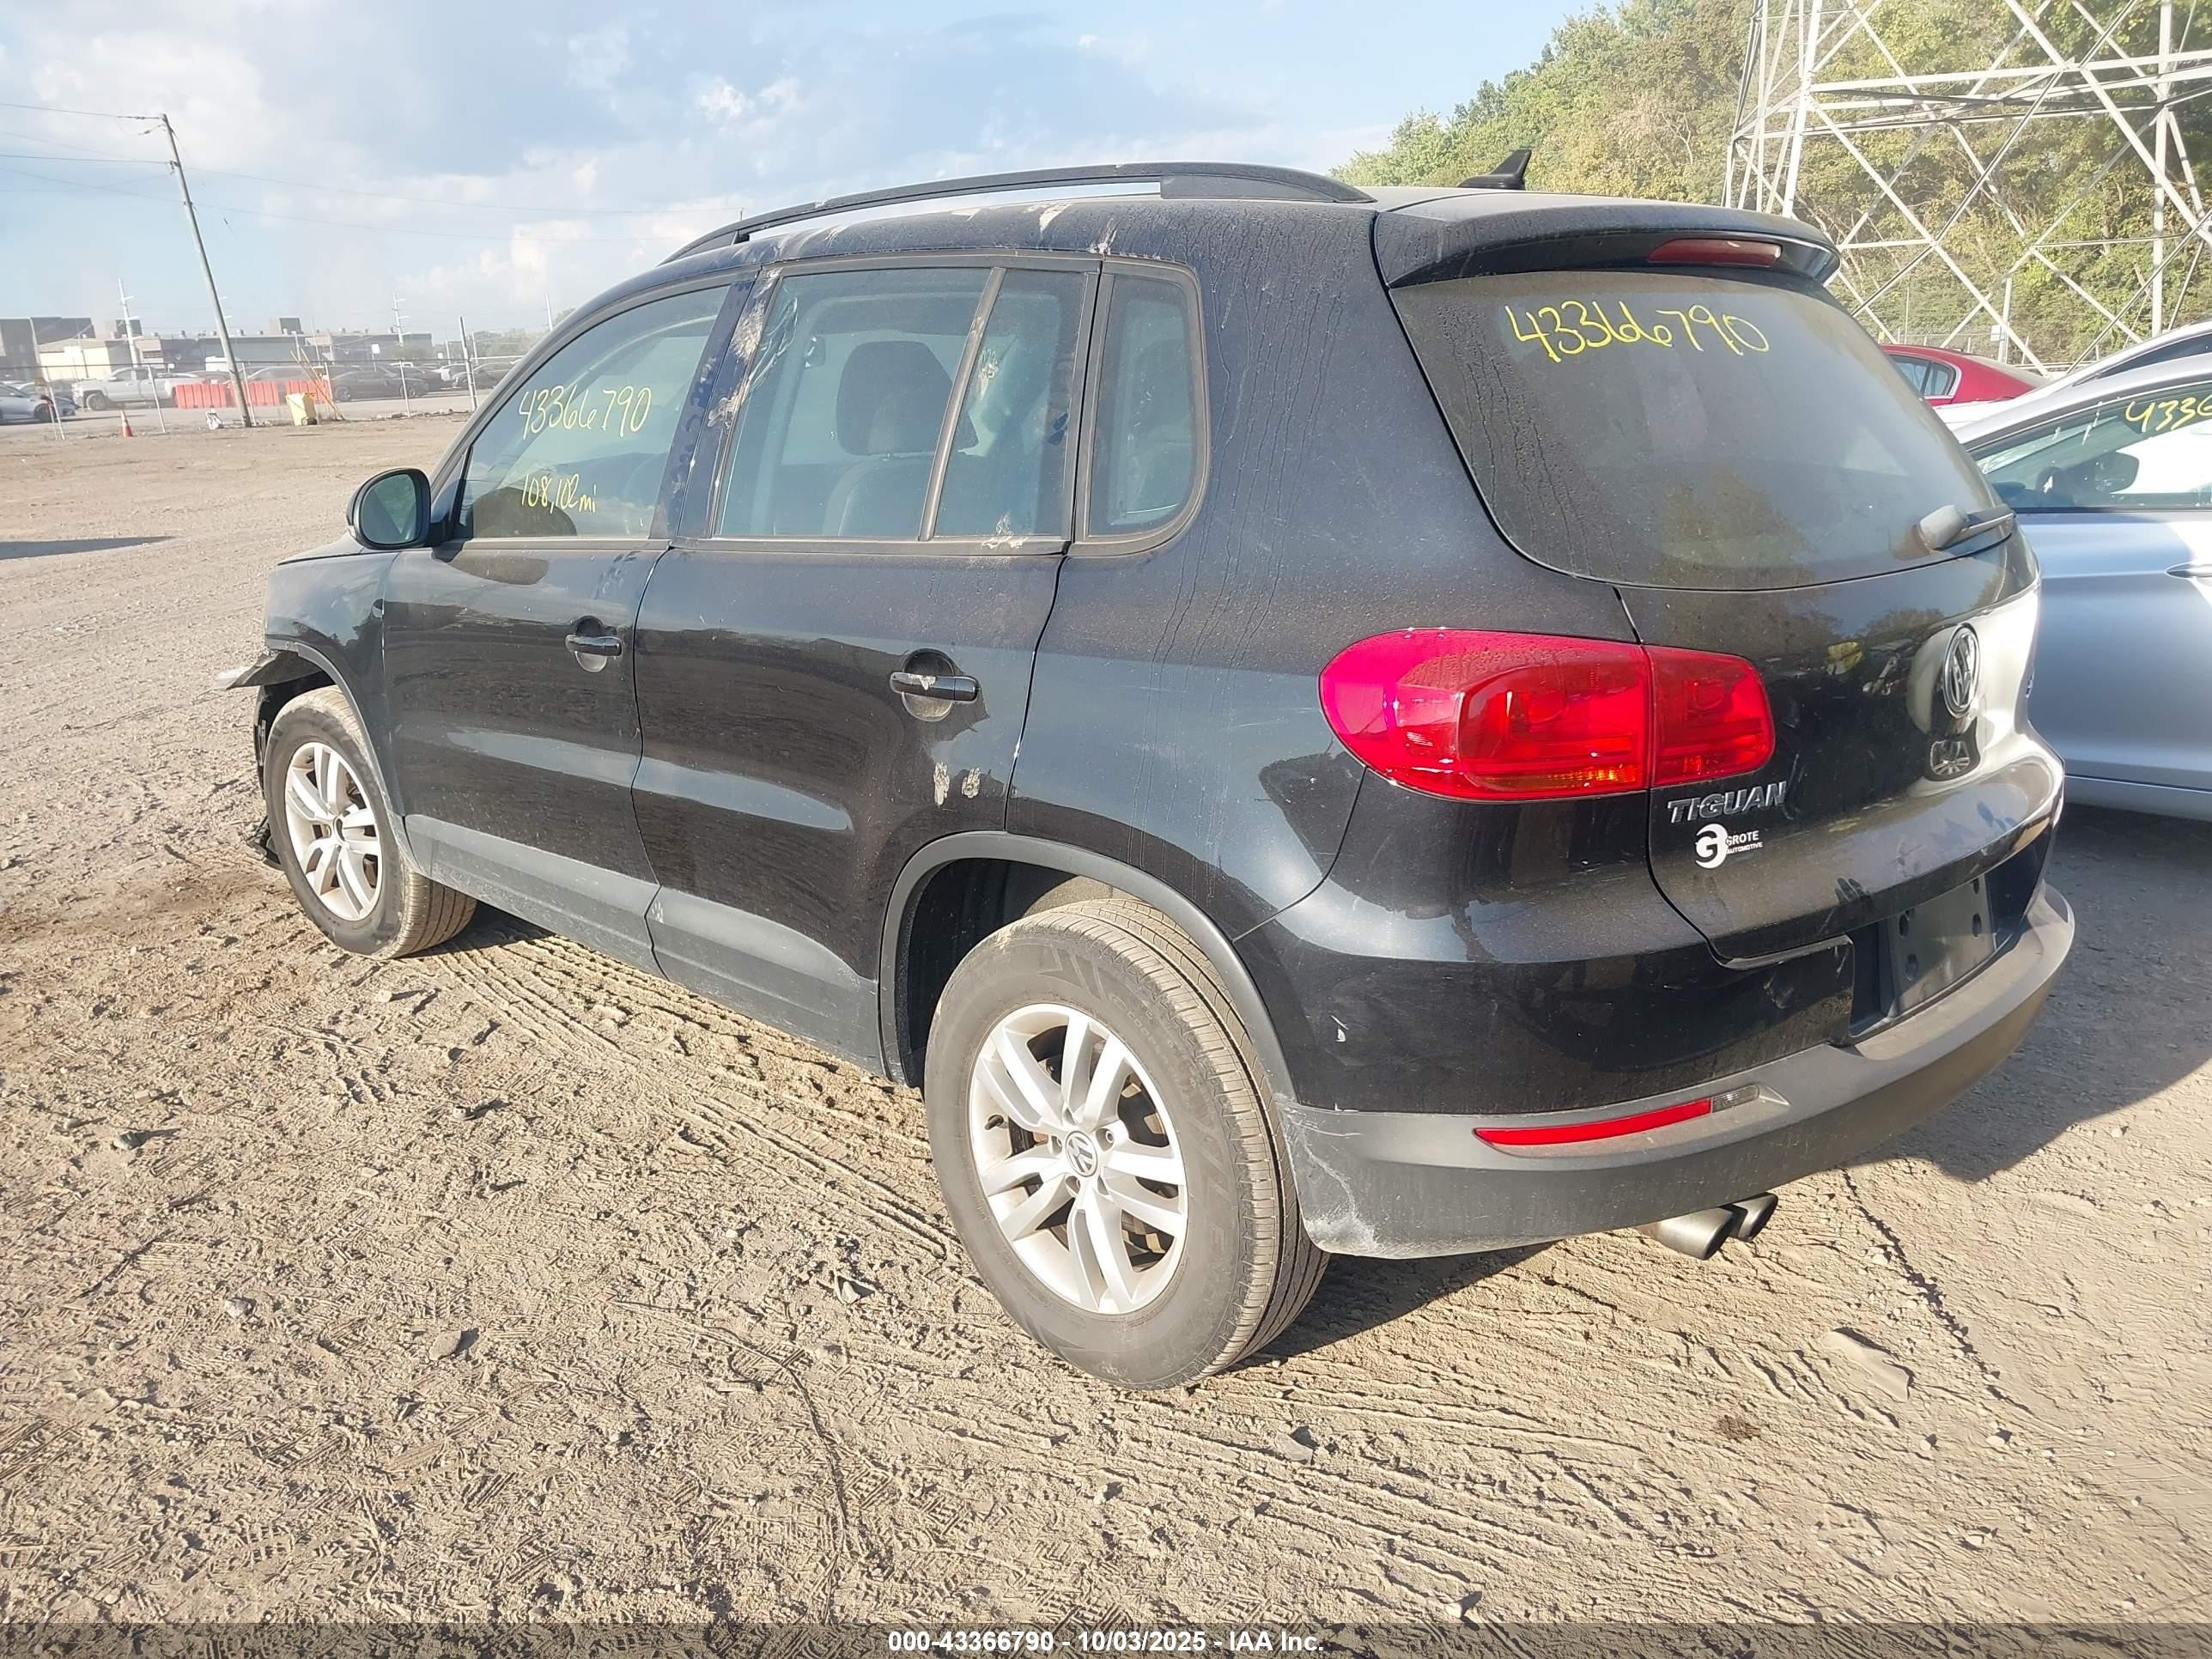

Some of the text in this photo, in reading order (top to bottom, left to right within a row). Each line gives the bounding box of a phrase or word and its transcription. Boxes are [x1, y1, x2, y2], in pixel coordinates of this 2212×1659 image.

[1504, 300, 1770, 362] 43366790
[519, 385, 651, 441] 43366790
[1667, 781, 1787, 823] TIGUAN
[1726, 830, 1759, 846] GROTE
[1727, 841, 1764, 855] AUTOMOTIVE
